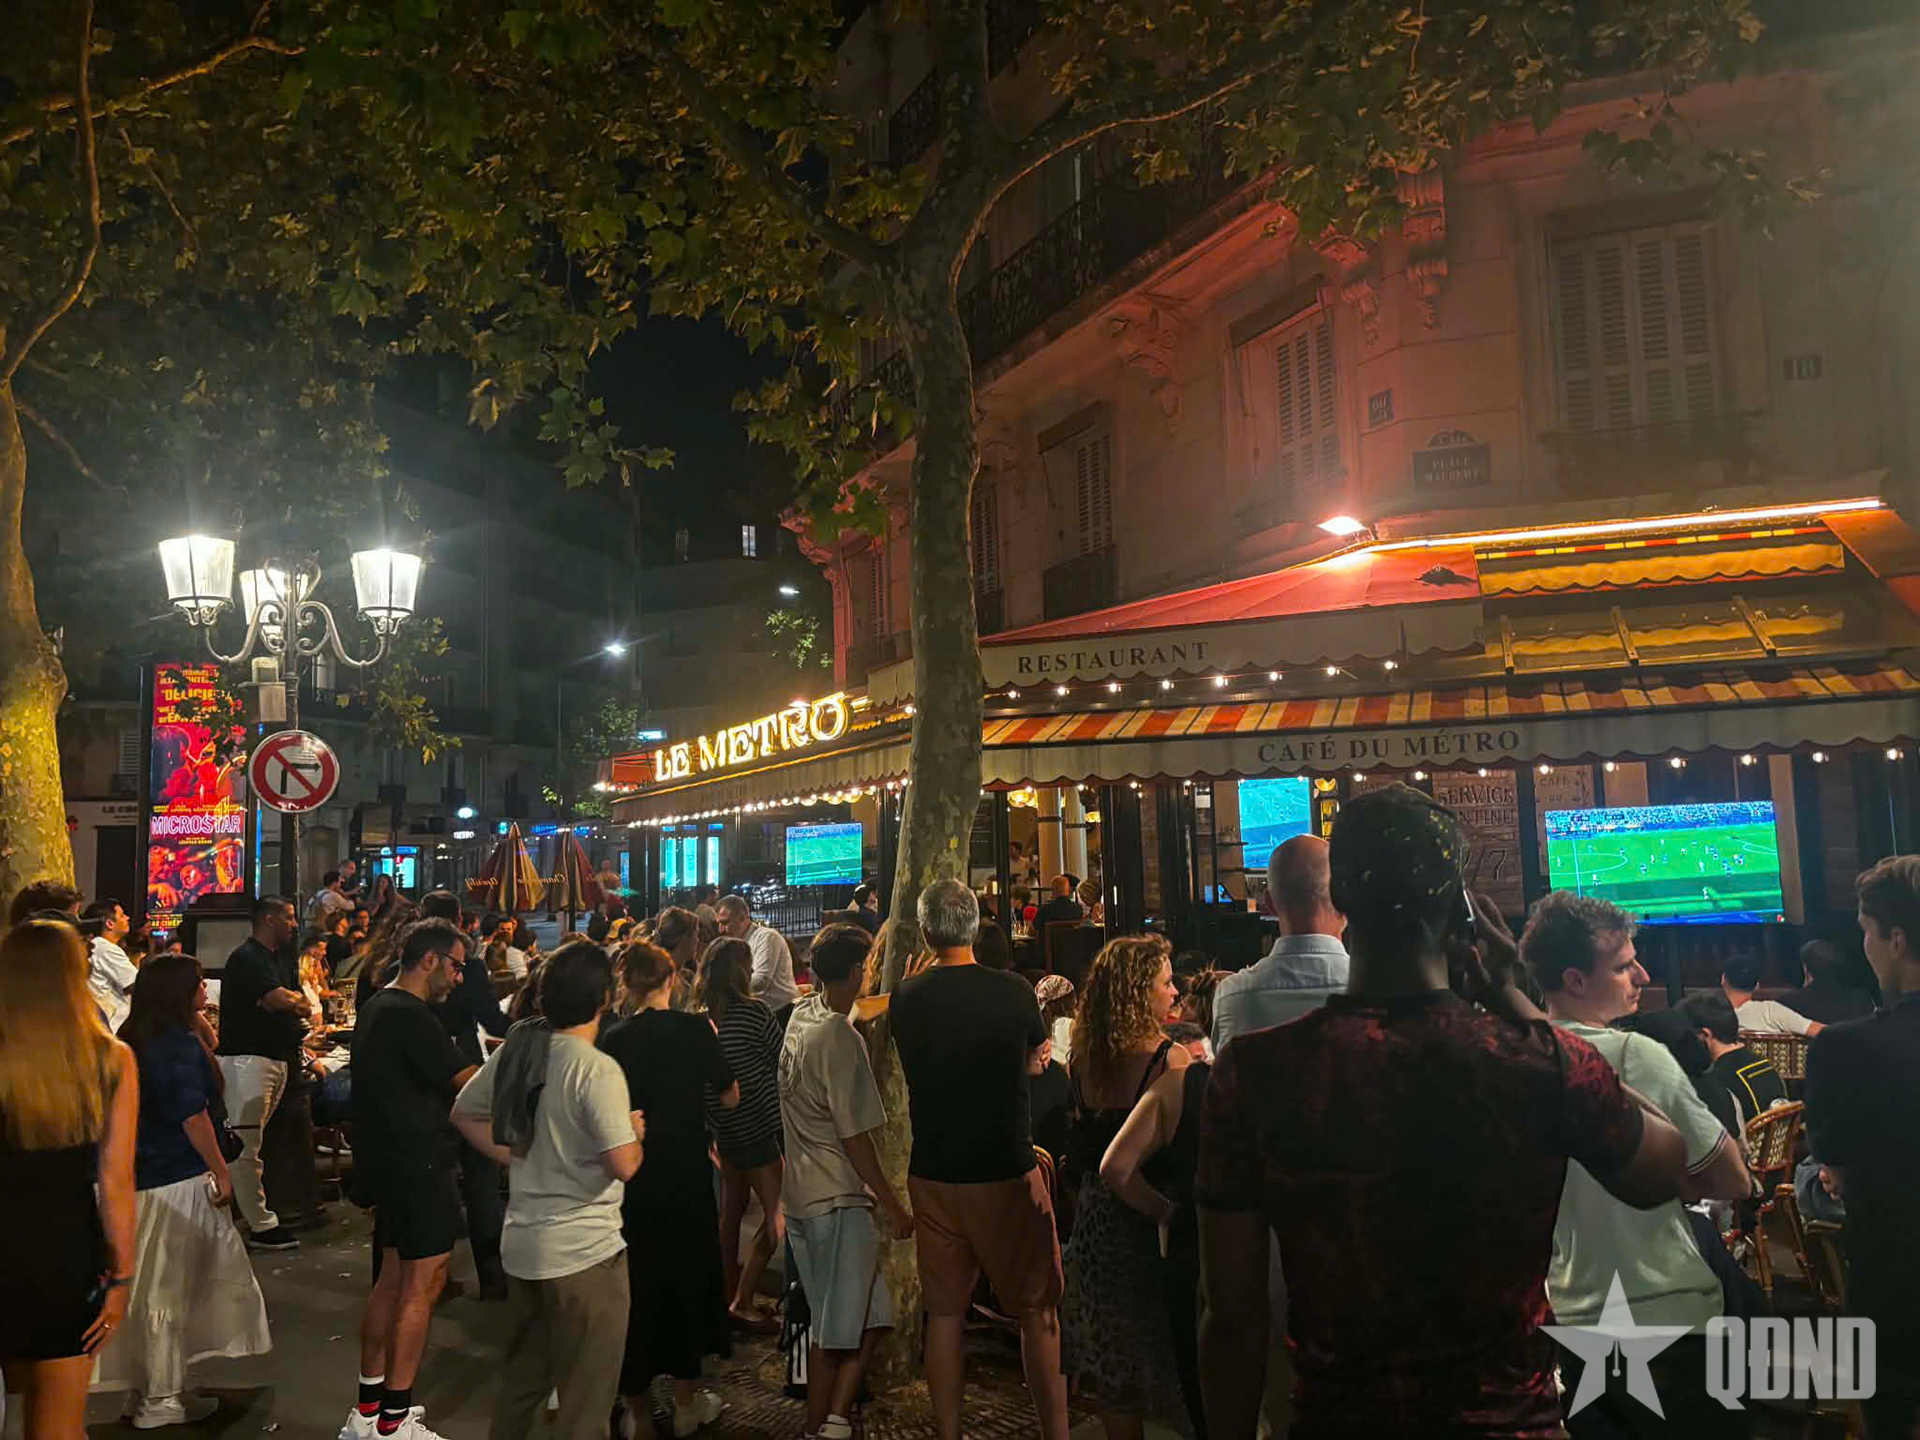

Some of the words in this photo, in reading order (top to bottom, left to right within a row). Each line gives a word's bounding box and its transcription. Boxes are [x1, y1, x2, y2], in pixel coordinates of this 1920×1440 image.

[1018, 642, 1208, 674] RESTAURANT
[655, 742, 691, 782] LE
[698, 691, 850, 772] METRO
[1258, 735, 1337, 763] CAFÉ
[1350, 738, 1389, 759] DU
[1404, 728, 1519, 757] MÉTRO
[1438, 784, 1514, 805] SERVICE
[151, 815, 241, 835] MICROSTAR
[1456, 808, 1515, 827] NTINU
